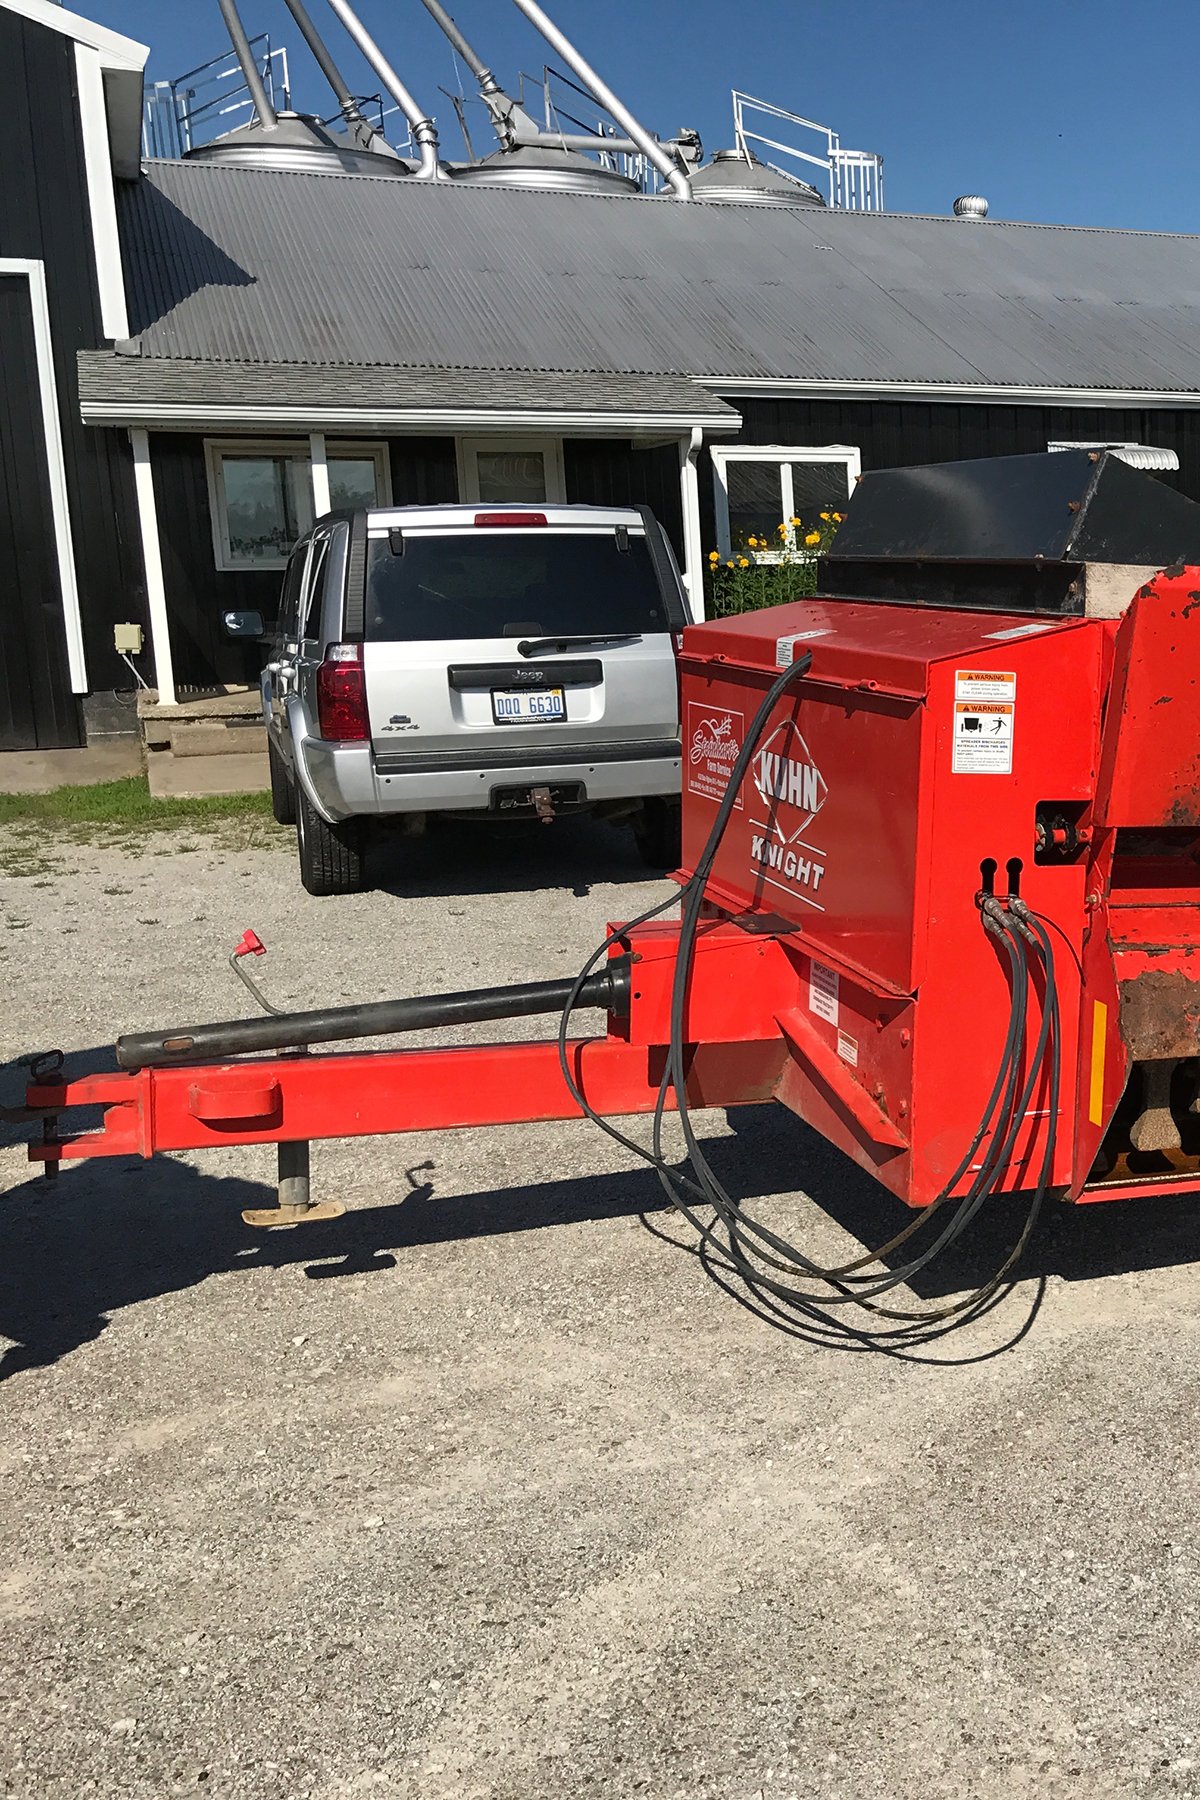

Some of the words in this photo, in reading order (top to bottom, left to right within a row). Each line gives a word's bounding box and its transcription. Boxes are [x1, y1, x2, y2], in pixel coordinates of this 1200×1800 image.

[512, 669, 543, 682] Jeep
[974, 674, 1005, 682] WARNING
[497, 698, 521, 715] DQQ
[529, 696, 561, 713] 6630
[971, 705, 1006, 713] WARNING
[760, 750, 818, 813] KUHN
[751, 835, 825, 890] KNIGHT
